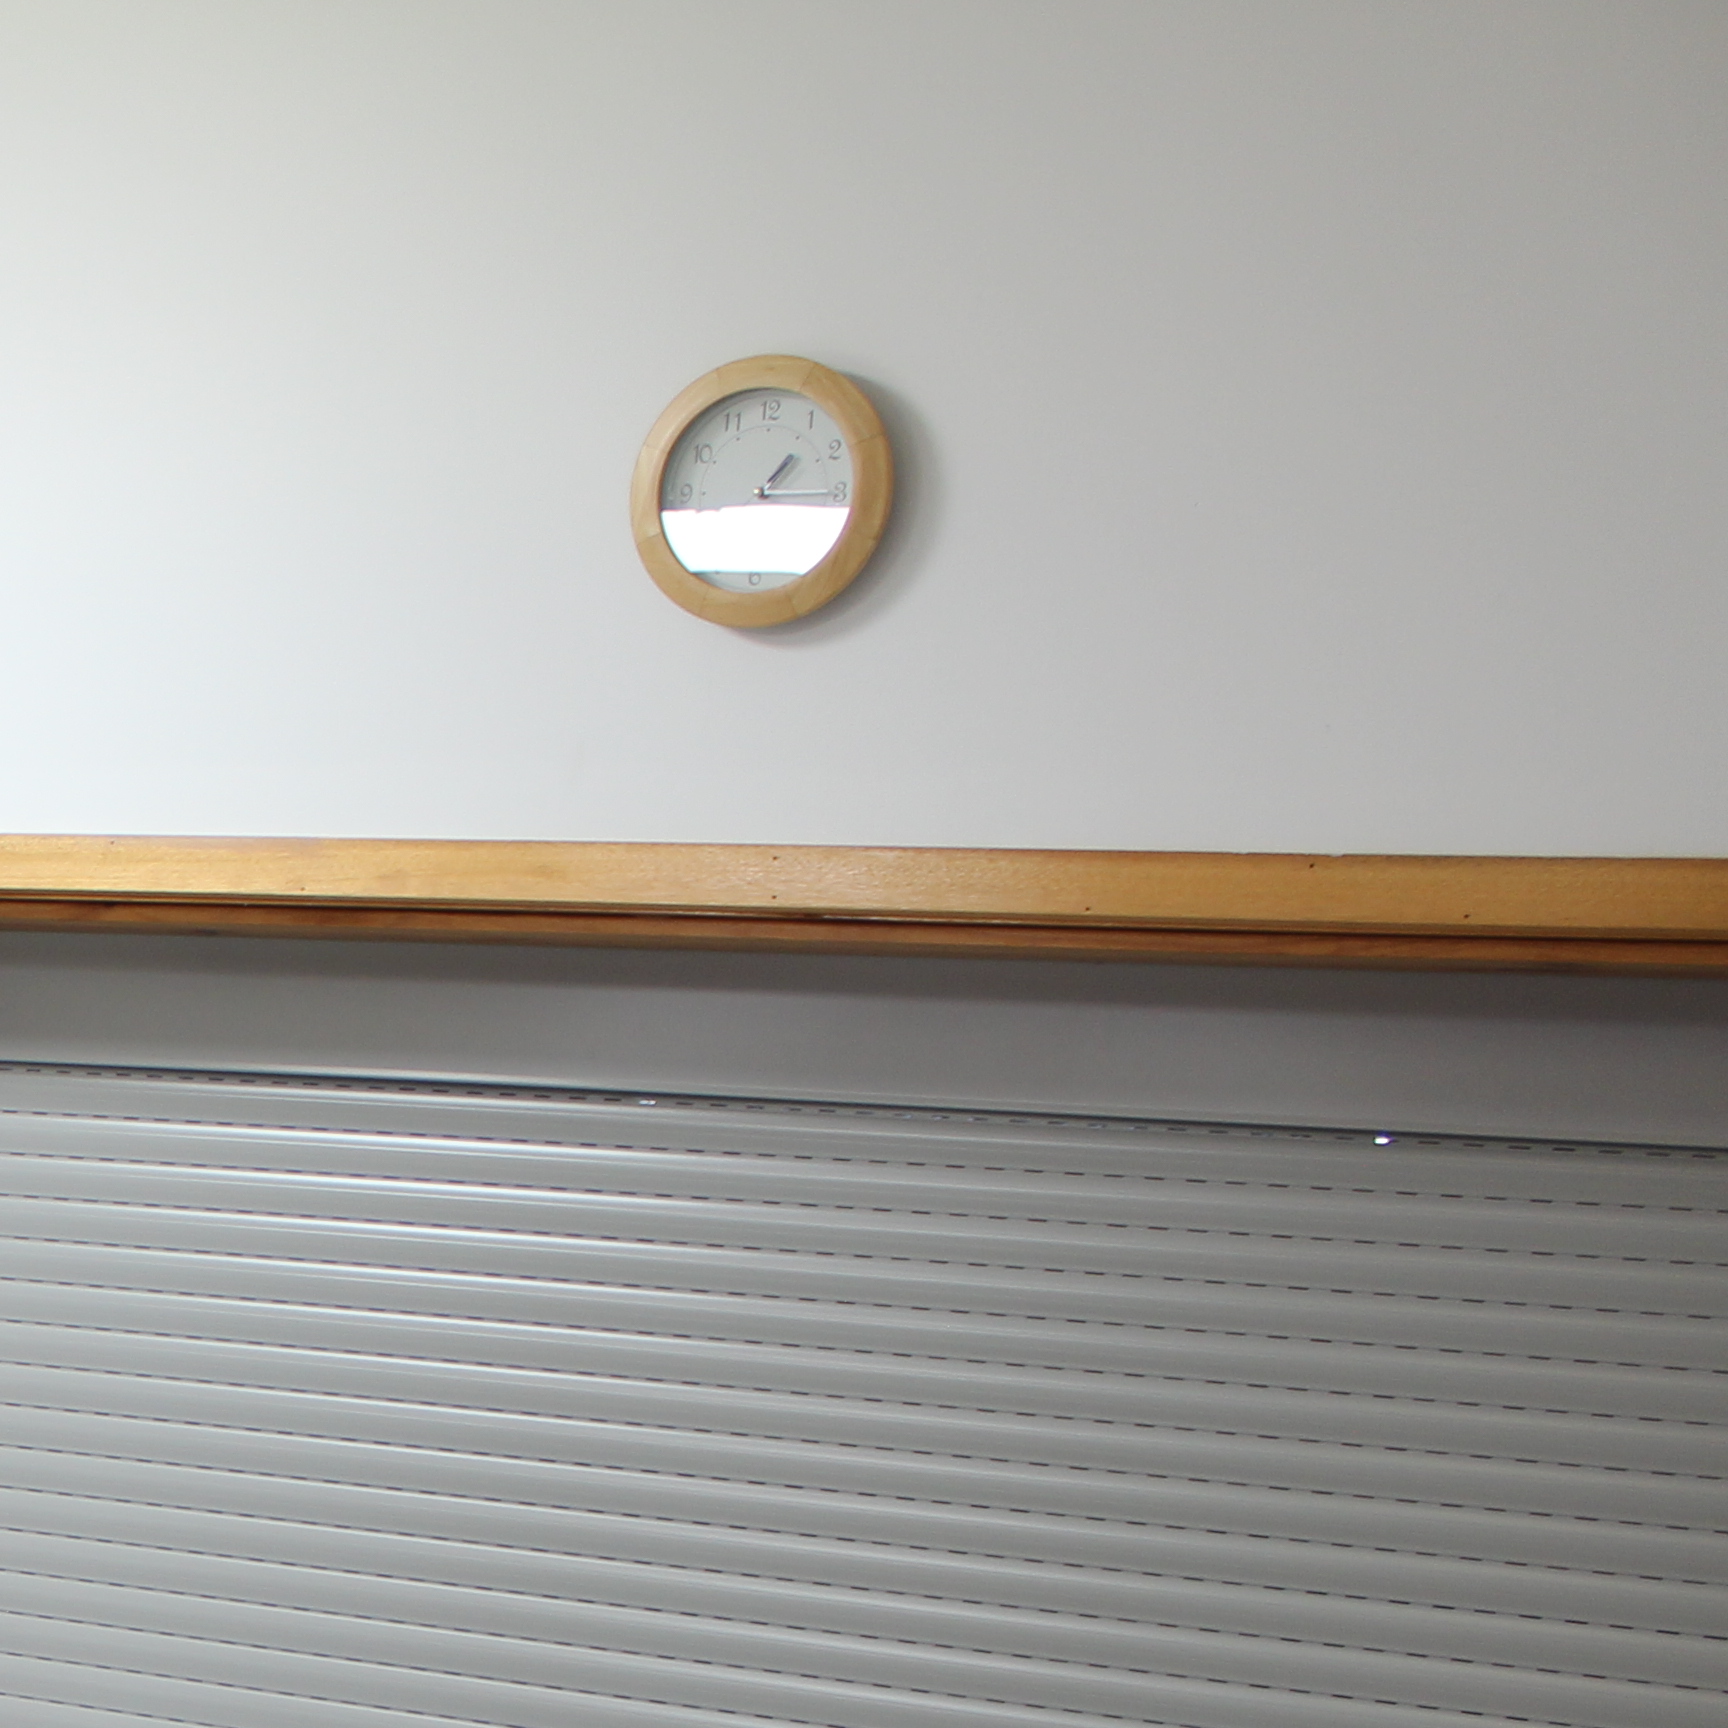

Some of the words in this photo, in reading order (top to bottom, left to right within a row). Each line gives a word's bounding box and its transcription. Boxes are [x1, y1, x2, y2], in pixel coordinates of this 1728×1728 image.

[761, 400, 781, 421] 12
[808, 409, 815, 430] 1
[724, 412, 742, 432] 11
[694, 444, 713, 464] 10
[828, 439, 842, 461] 2
[680, 484, 693, 504] 9
[833, 482, 847, 502] 3
